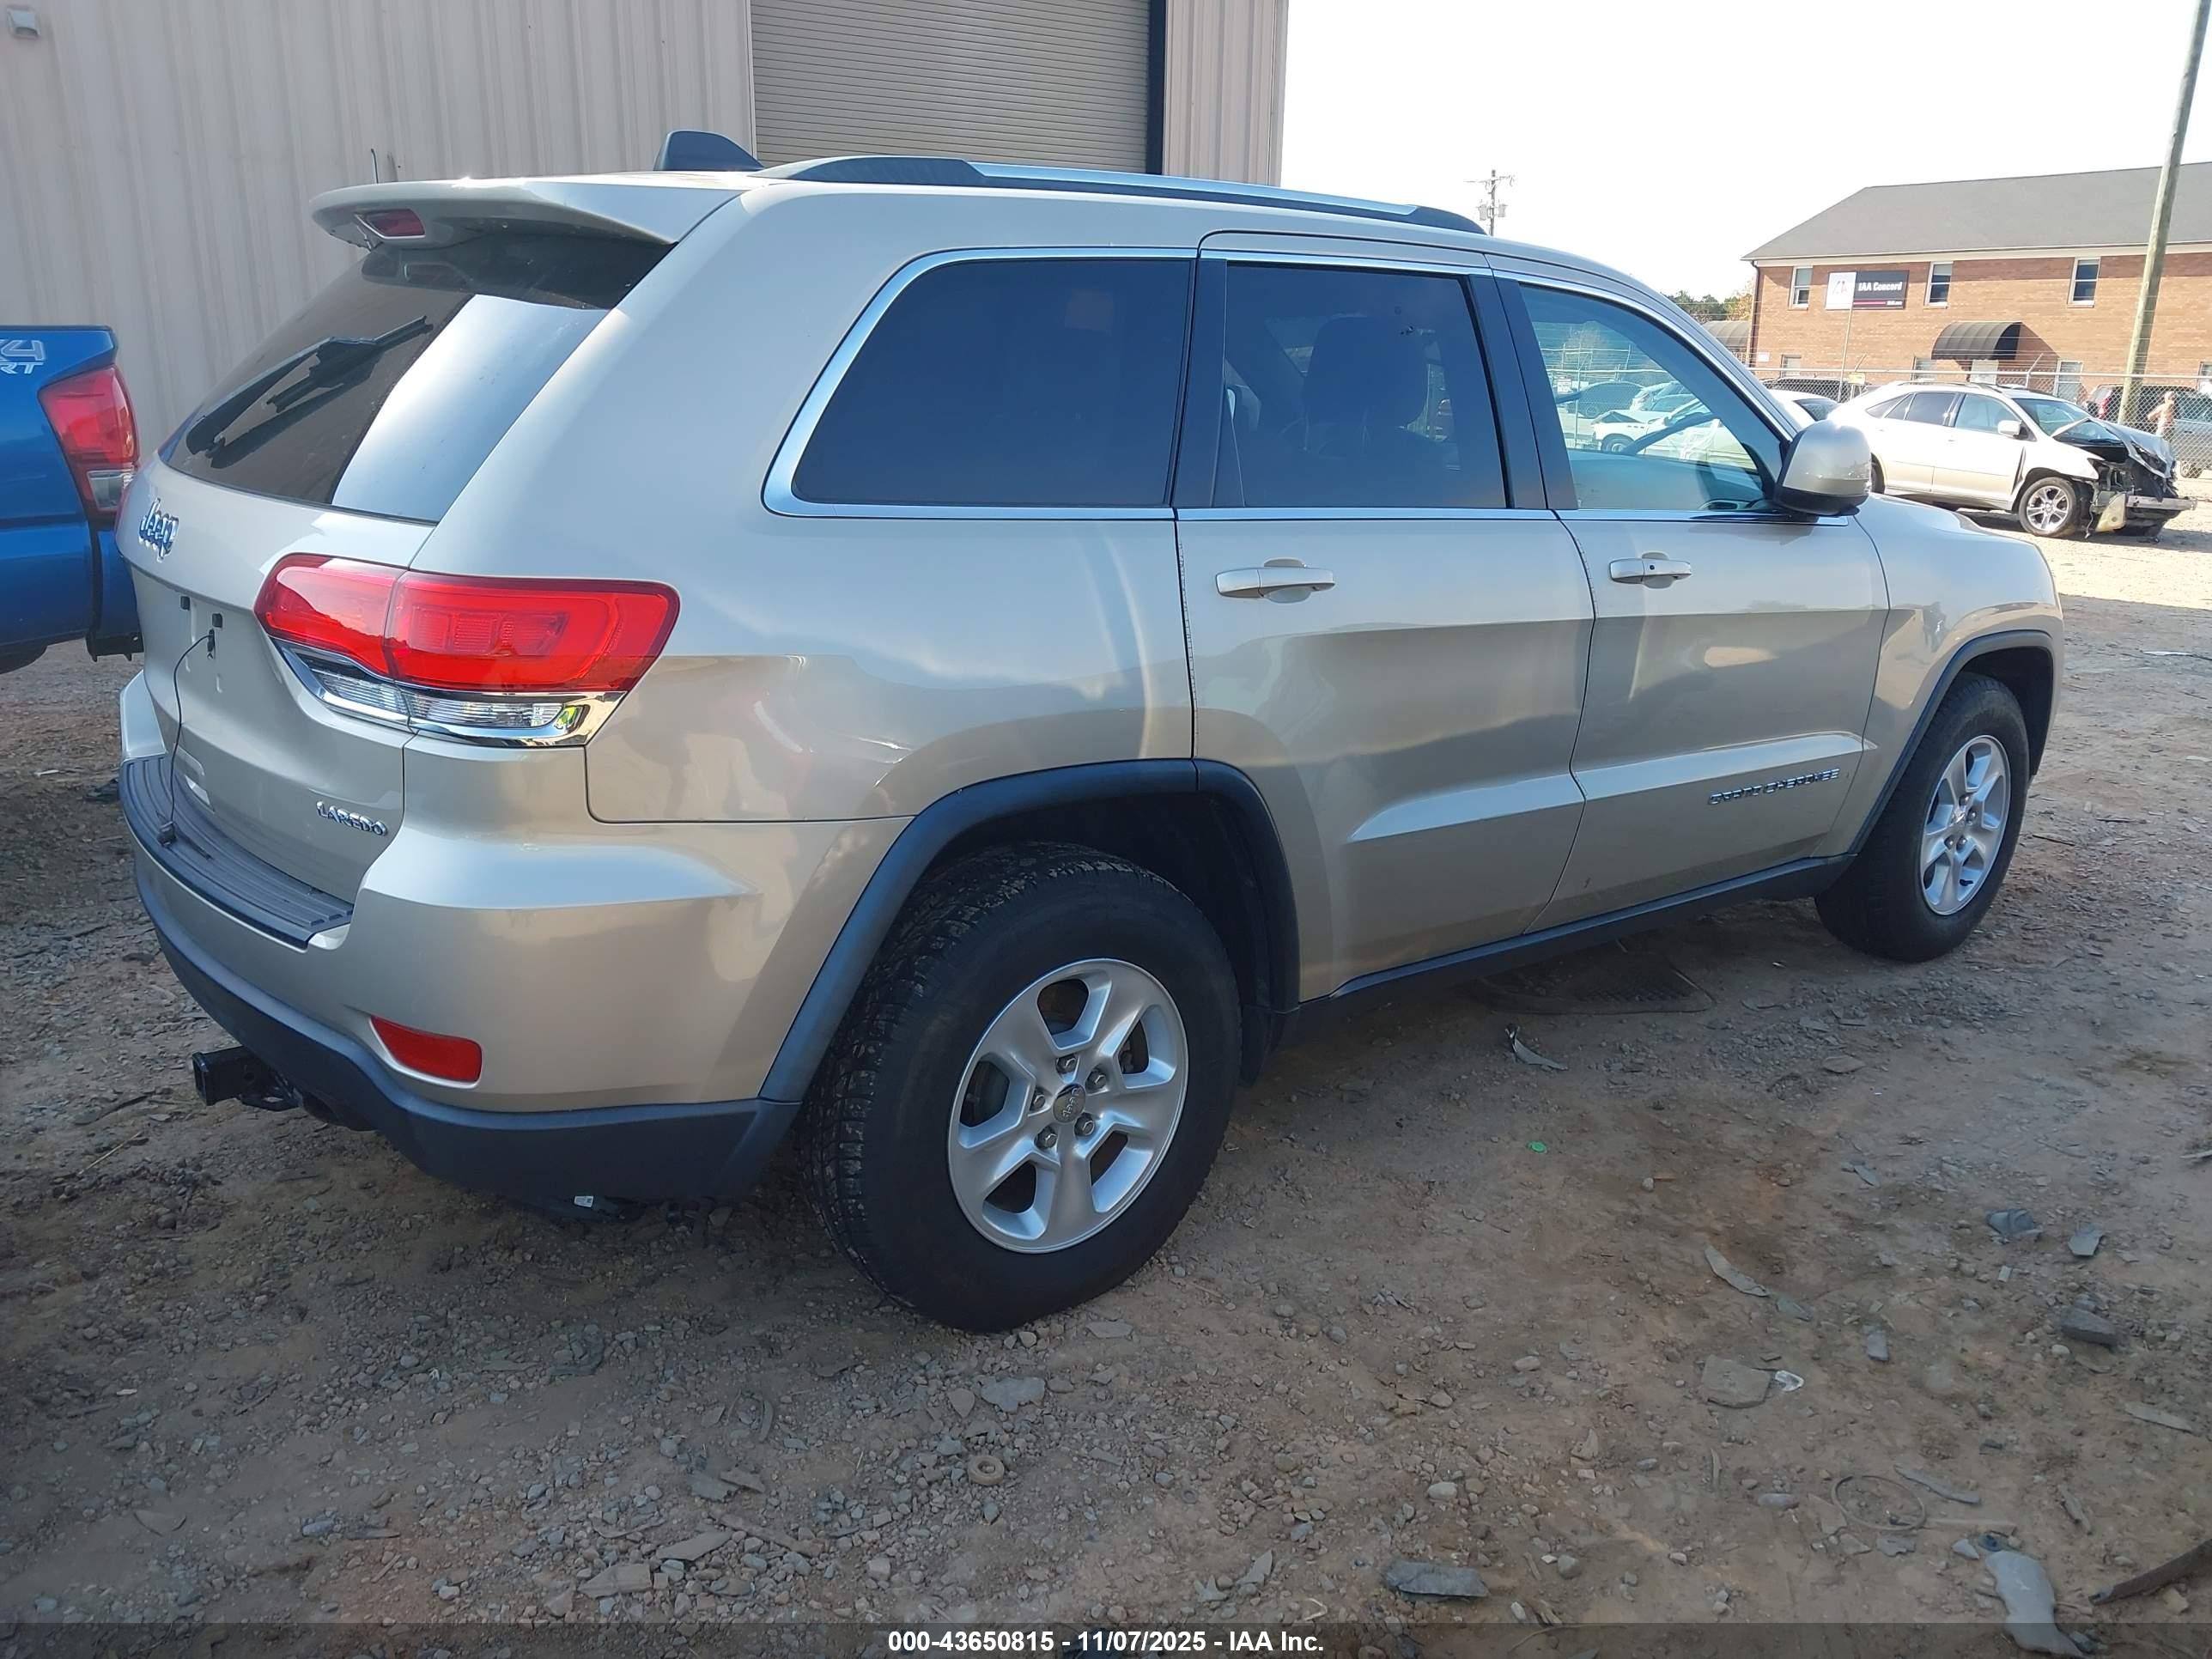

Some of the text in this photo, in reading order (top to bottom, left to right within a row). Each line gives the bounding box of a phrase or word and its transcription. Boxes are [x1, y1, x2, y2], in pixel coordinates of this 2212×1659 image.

[1873, 282, 1903, 291] Concord
[138, 498, 179, 562] Jeep
[316, 800, 389, 836] LAREDO
